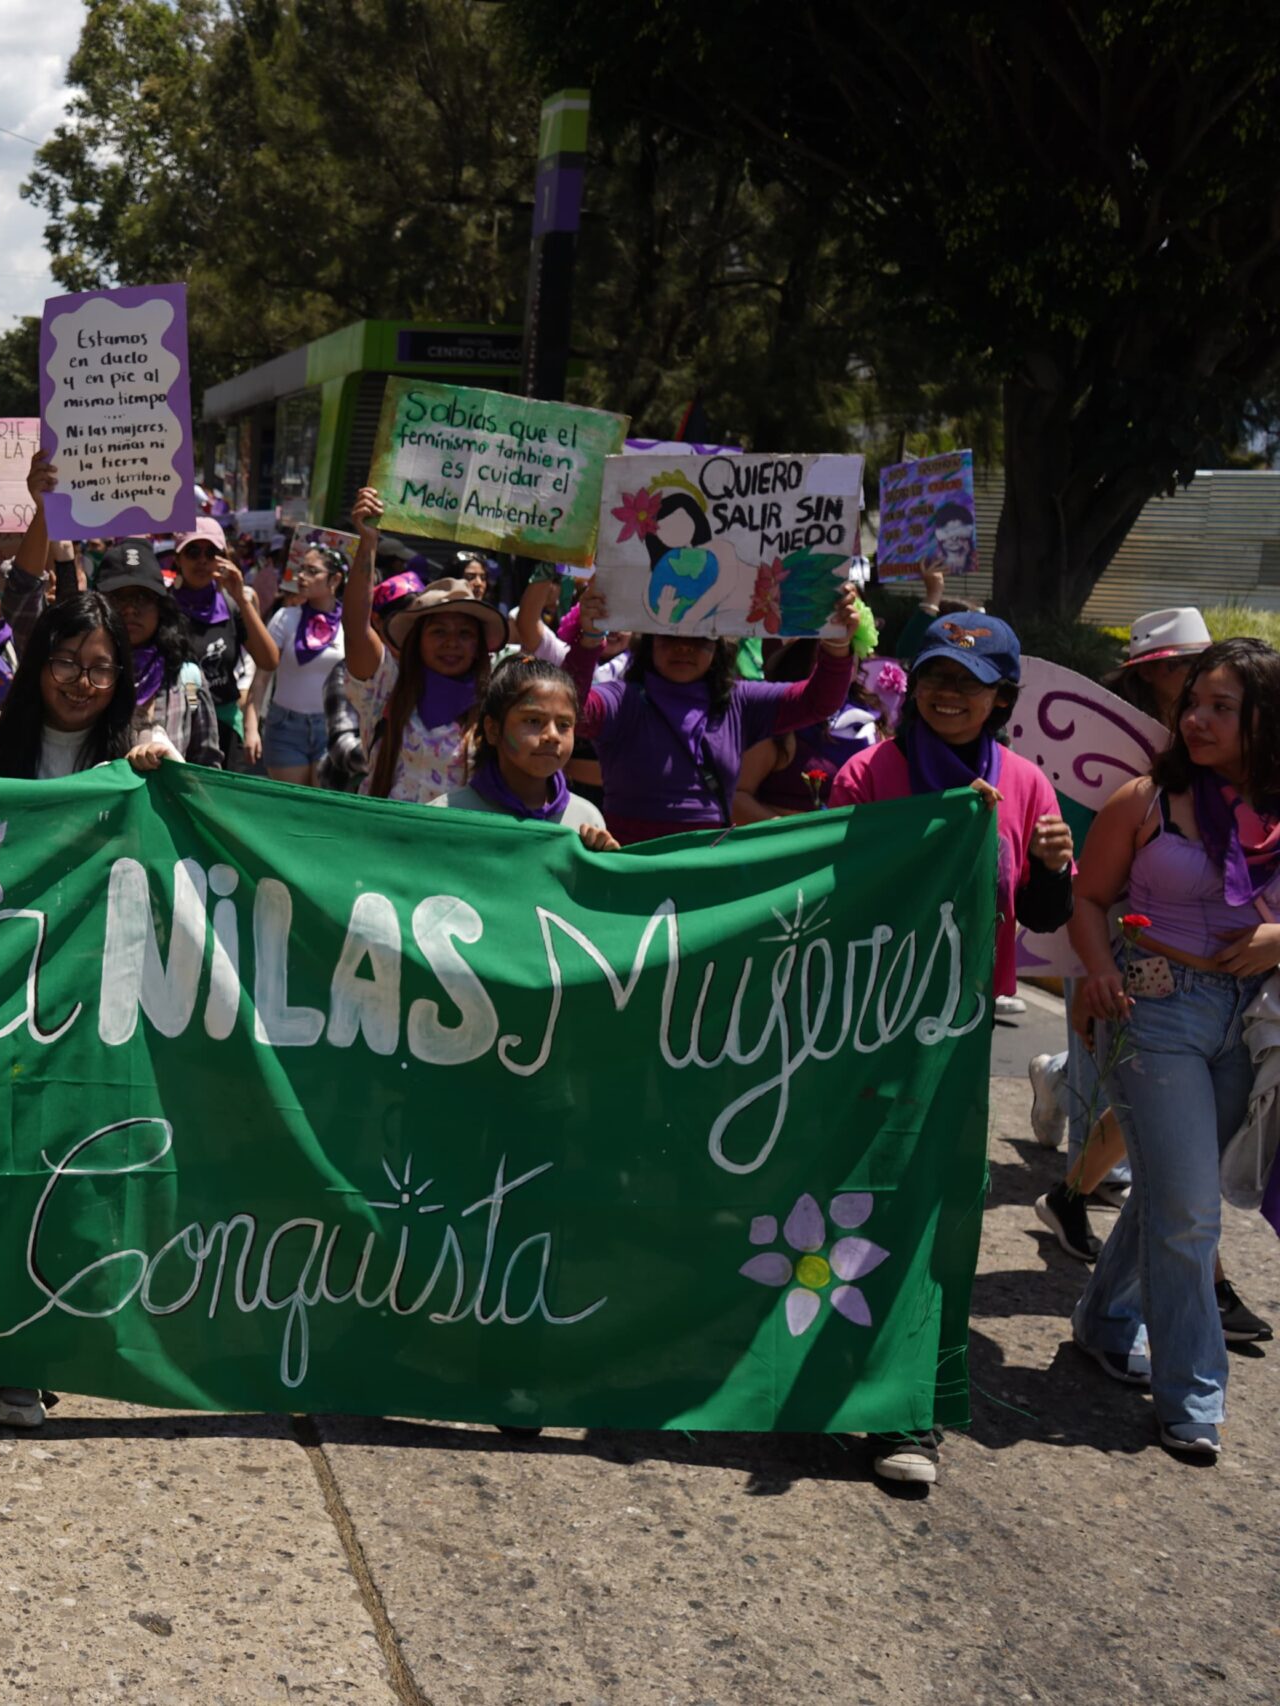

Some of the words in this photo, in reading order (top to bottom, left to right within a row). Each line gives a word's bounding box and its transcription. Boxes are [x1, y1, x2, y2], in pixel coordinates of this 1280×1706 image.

[77, 329, 148, 349] Estamos
[69, 357, 88, 368] en
[101, 351, 148, 365] duelo
[427, 346, 475, 359] CENTRO
[85, 374, 104, 384] en
[110, 371, 135, 389] pie
[144, 368, 159, 383] al
[64, 396, 114, 408] mismo
[118, 391, 167, 410] tiempo
[66, 425, 83, 438] Ni
[88, 425, 107, 437] las
[557, 424, 577, 448] el
[4, 441, 24, 459] LA
[63, 445, 78, 456] ni
[84, 443, 103, 455] las
[107, 439, 145, 452] niñas
[150, 439, 165, 449] ni
[398, 423, 487, 455] feminismo
[496, 439, 572, 470] tambien
[79, 459, 93, 472] la
[102, 456, 148, 468] tierra
[71, 476, 111, 490] somos
[116, 470, 171, 484] territorio
[441, 460, 464, 479] es
[478, 463, 541, 488] cuidar
[553, 473, 569, 494] el
[699, 456, 803, 500] QUIERO
[90, 491, 105, 502] de
[110, 485, 166, 502] disputa
[399, 481, 458, 510] Medio
[464, 490, 563, 533] Ambiente?
[711, 502, 782, 535] SALIR
[795, 496, 843, 524] SIN
[760, 523, 846, 556] MIEDO
[498, 896, 986, 1174] Mujeres
